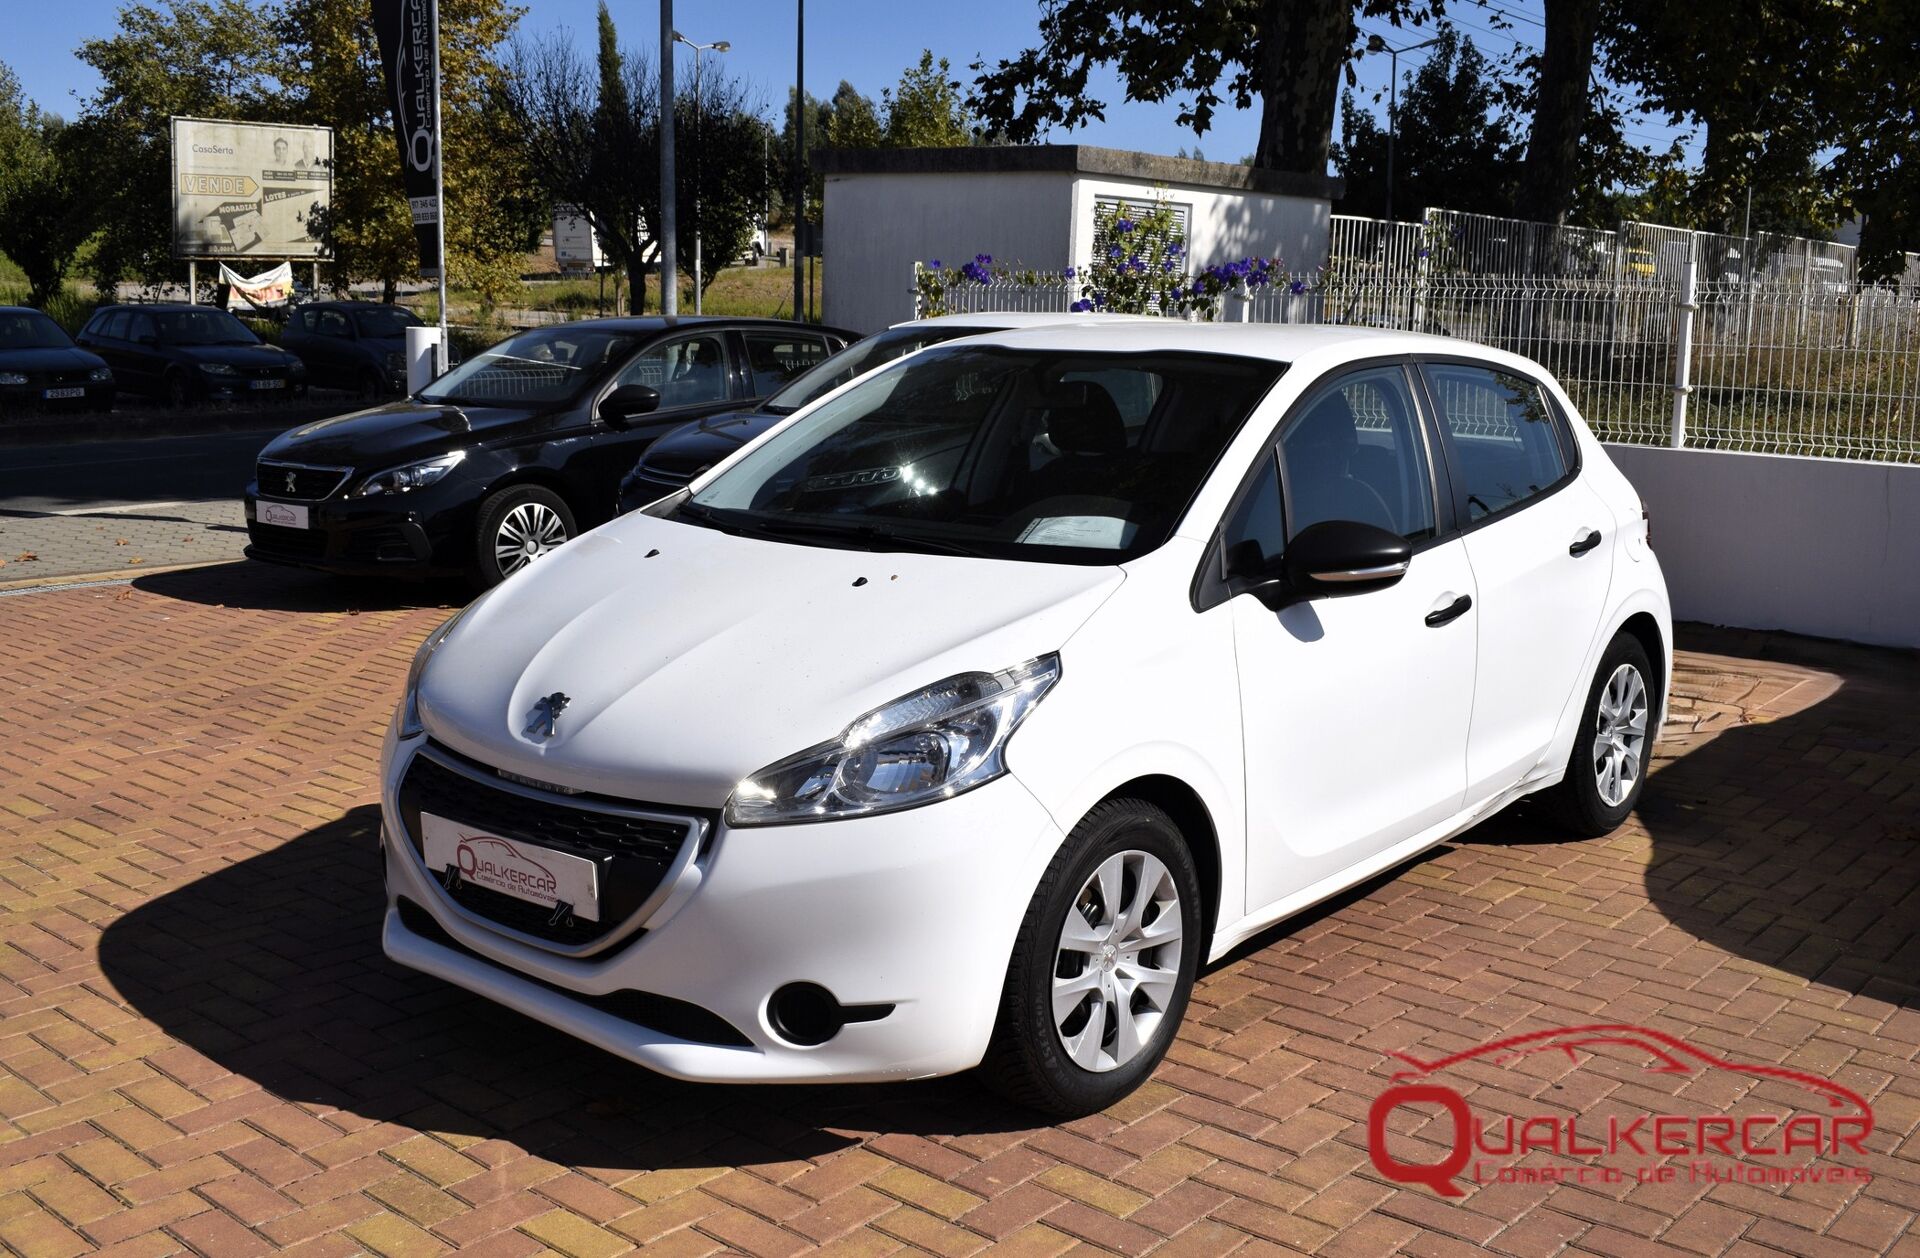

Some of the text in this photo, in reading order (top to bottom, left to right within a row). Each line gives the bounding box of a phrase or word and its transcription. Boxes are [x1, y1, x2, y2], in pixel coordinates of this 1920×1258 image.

[423, 49, 430, 65] de
[185, 175, 245, 194] VENDE
[264, 192, 287, 202] LOTES
[219, 203, 258, 214] MORADIAS
[457, 845, 556, 895] QUALKERCAR
[507, 882, 517, 892] de
